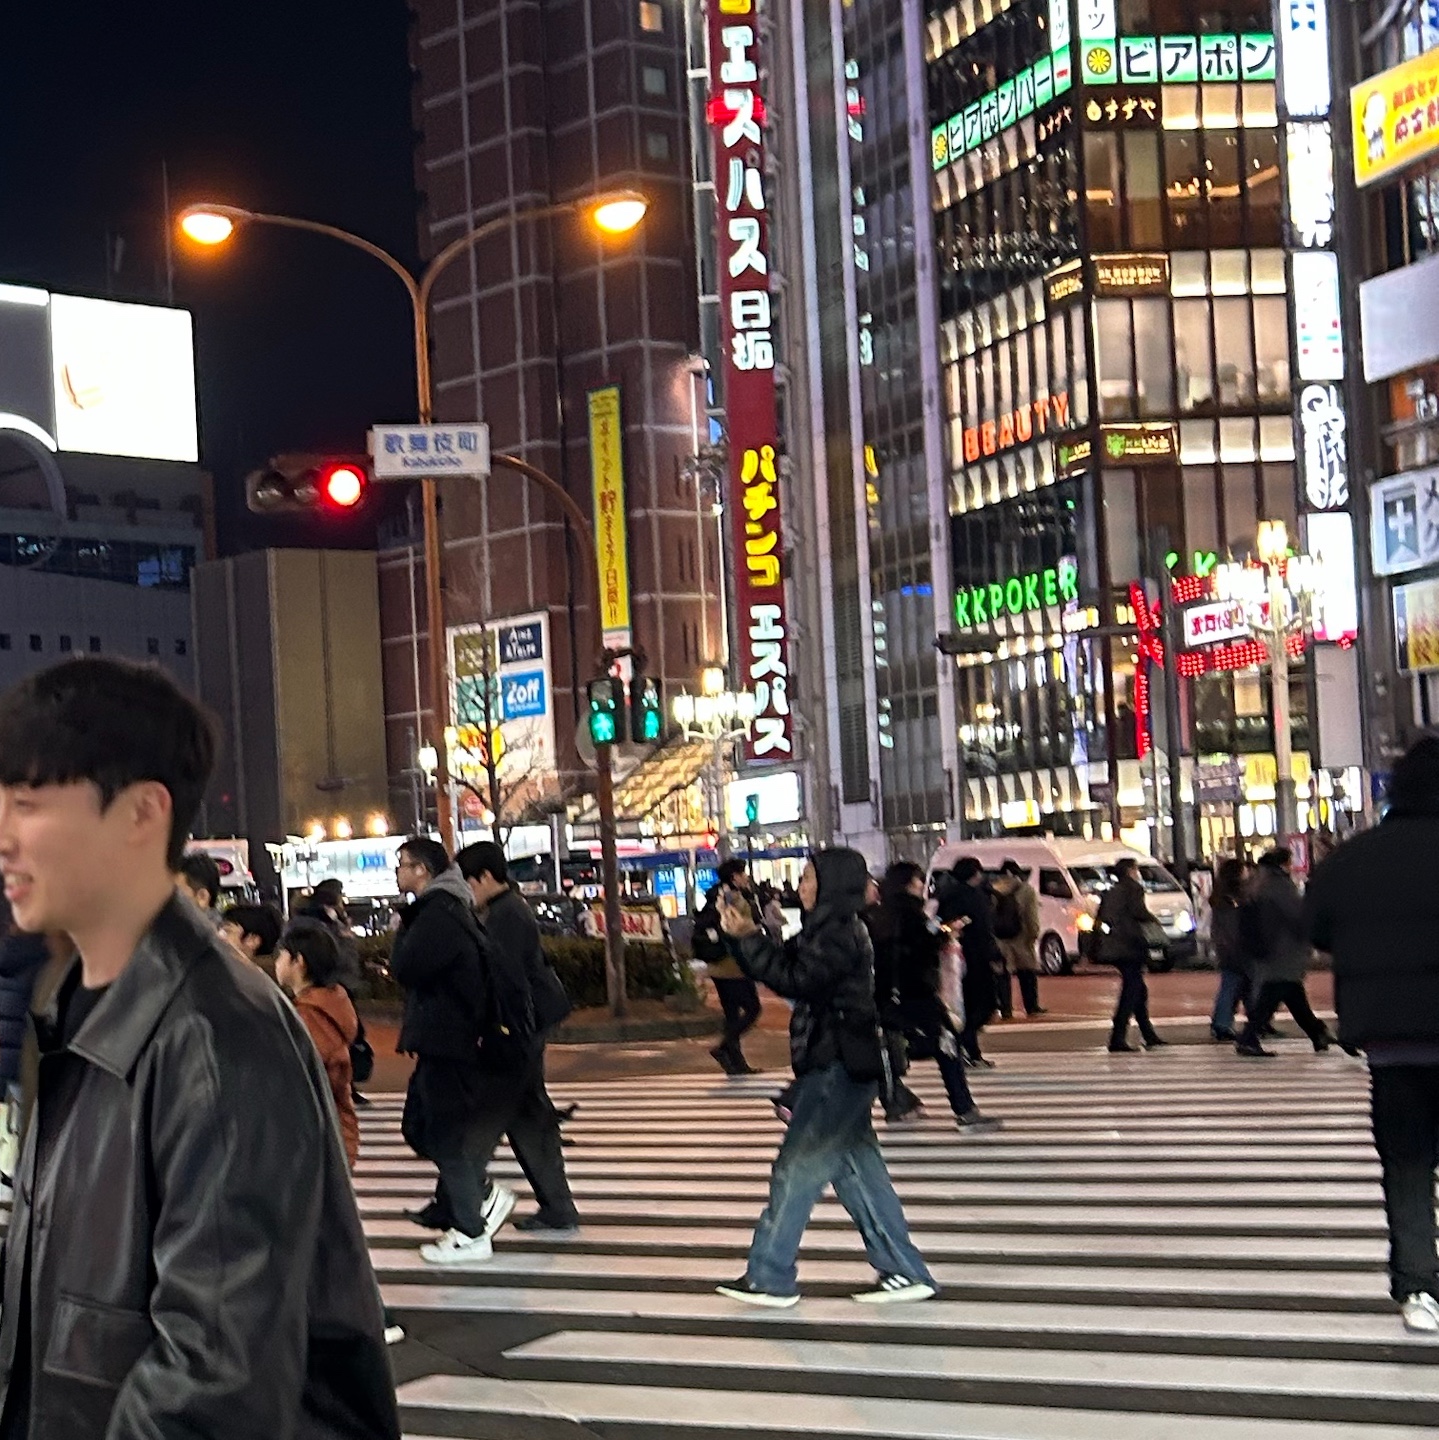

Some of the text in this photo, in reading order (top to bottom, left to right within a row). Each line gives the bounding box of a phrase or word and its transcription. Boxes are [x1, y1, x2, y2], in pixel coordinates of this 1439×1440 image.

[1124, 40, 1275, 77] ビアポン
[384, 431, 477, 454] 歌舞伎町
[964, 391, 1069, 463] BEAUTY
[740, 445, 781, 588] パチンコ
[956, 564, 1078, 628] KKPOKER
[506, 677, 540, 704] Zoff
[749, 604, 791, 756] エスパス
